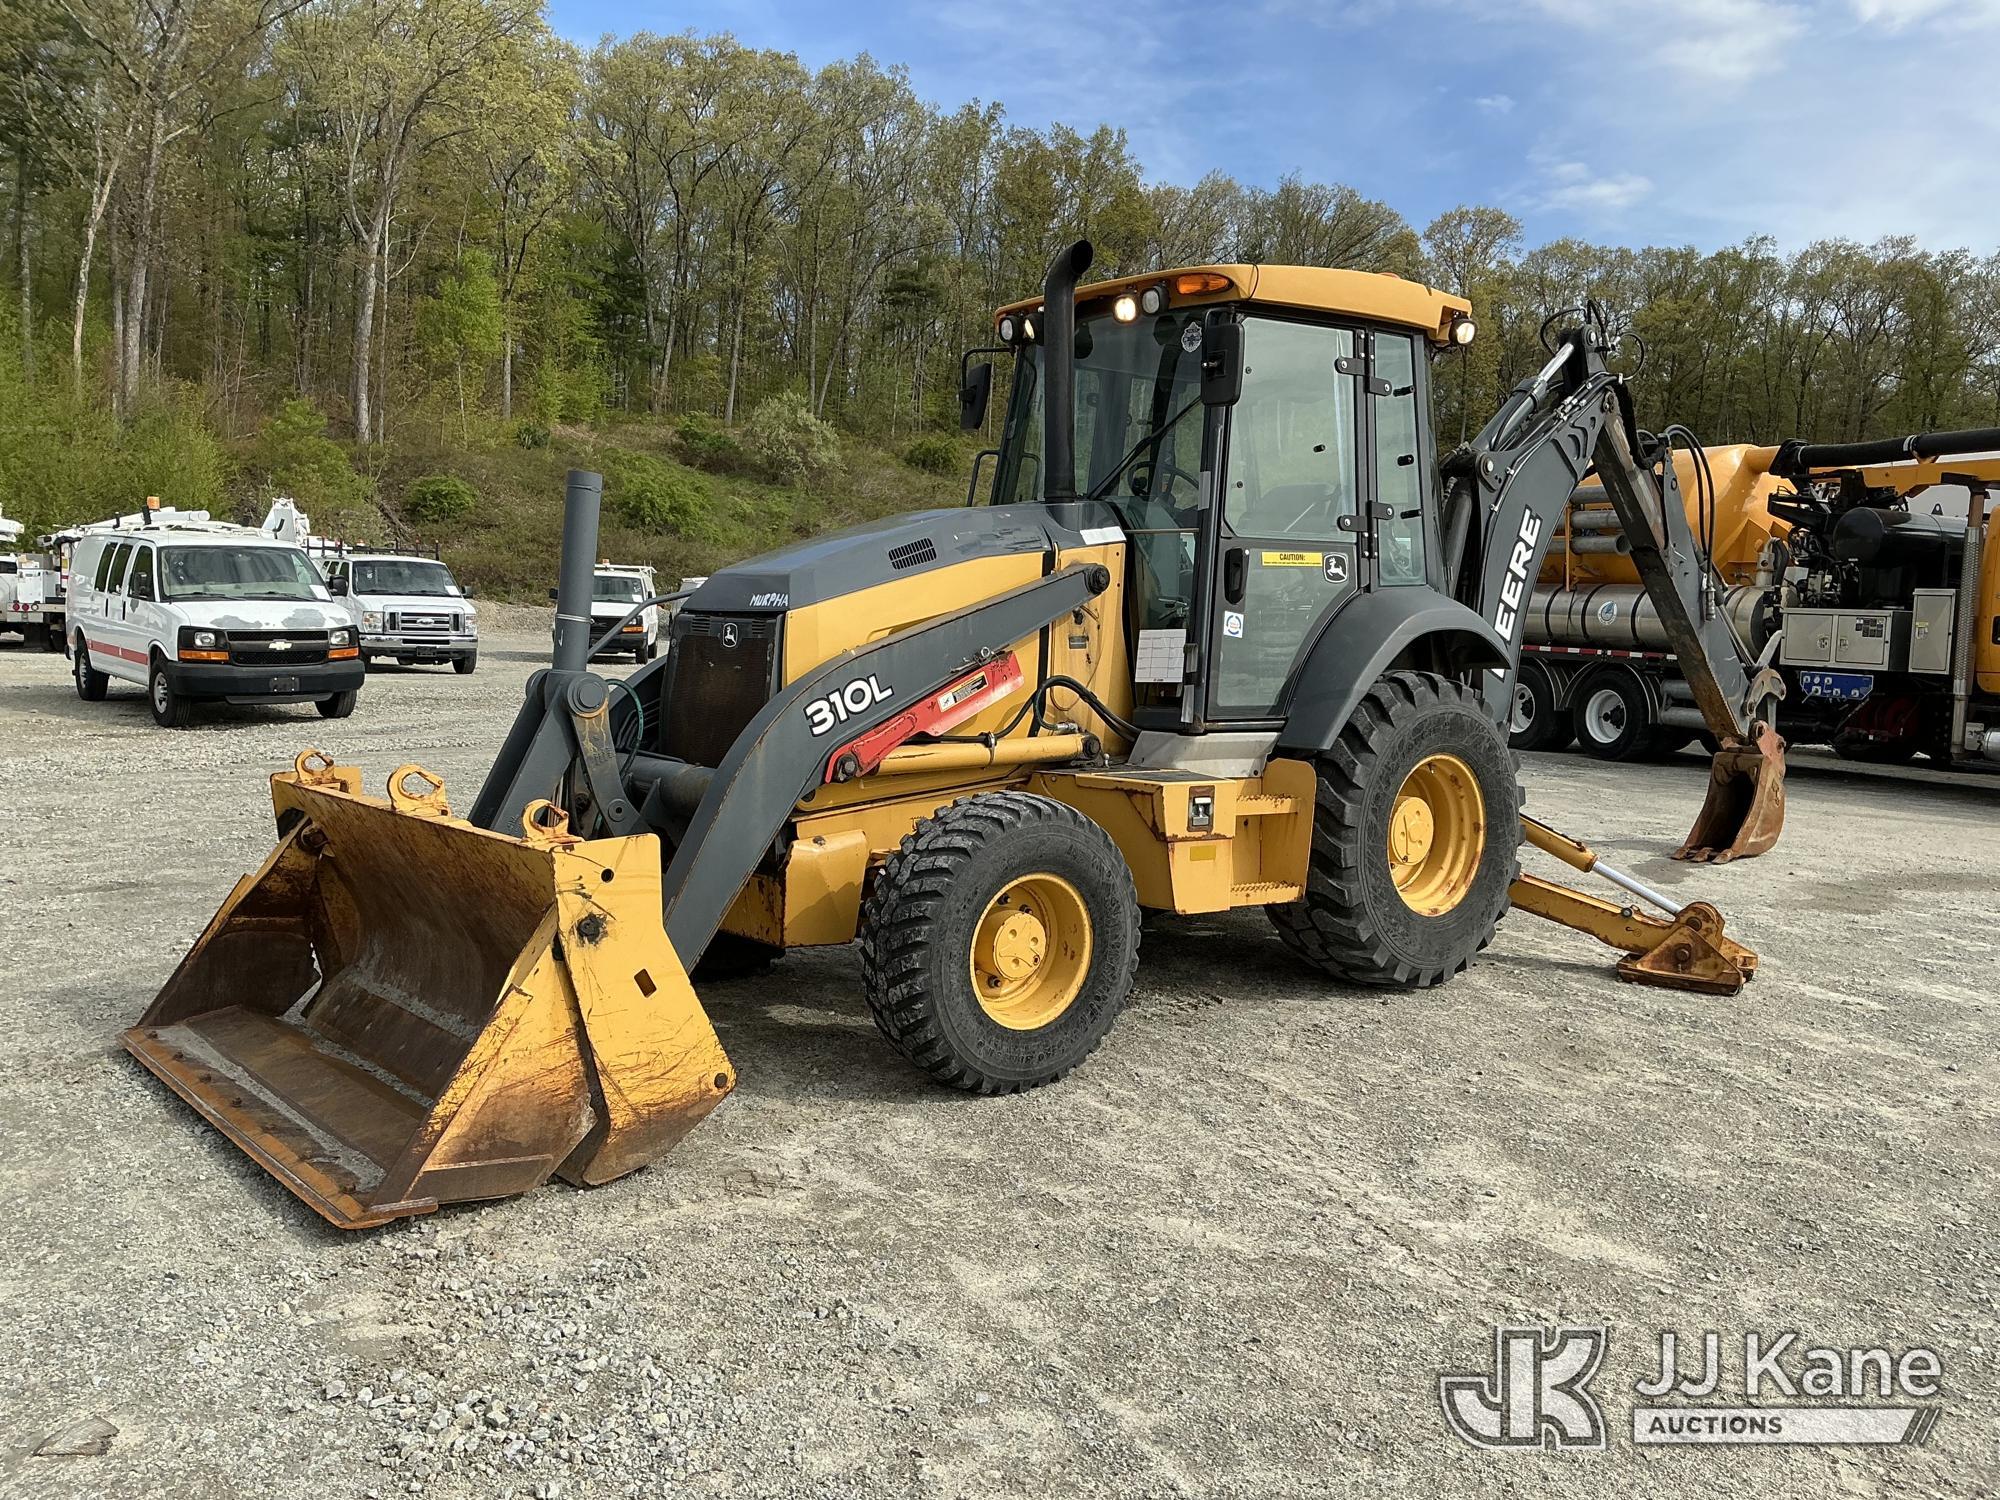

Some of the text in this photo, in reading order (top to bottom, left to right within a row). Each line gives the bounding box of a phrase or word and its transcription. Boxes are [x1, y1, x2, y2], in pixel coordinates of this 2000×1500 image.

[1279, 553, 1306, 561] CAUTION:
[1489, 505, 1543, 682] EERE
[803, 673, 894, 737] 310L
